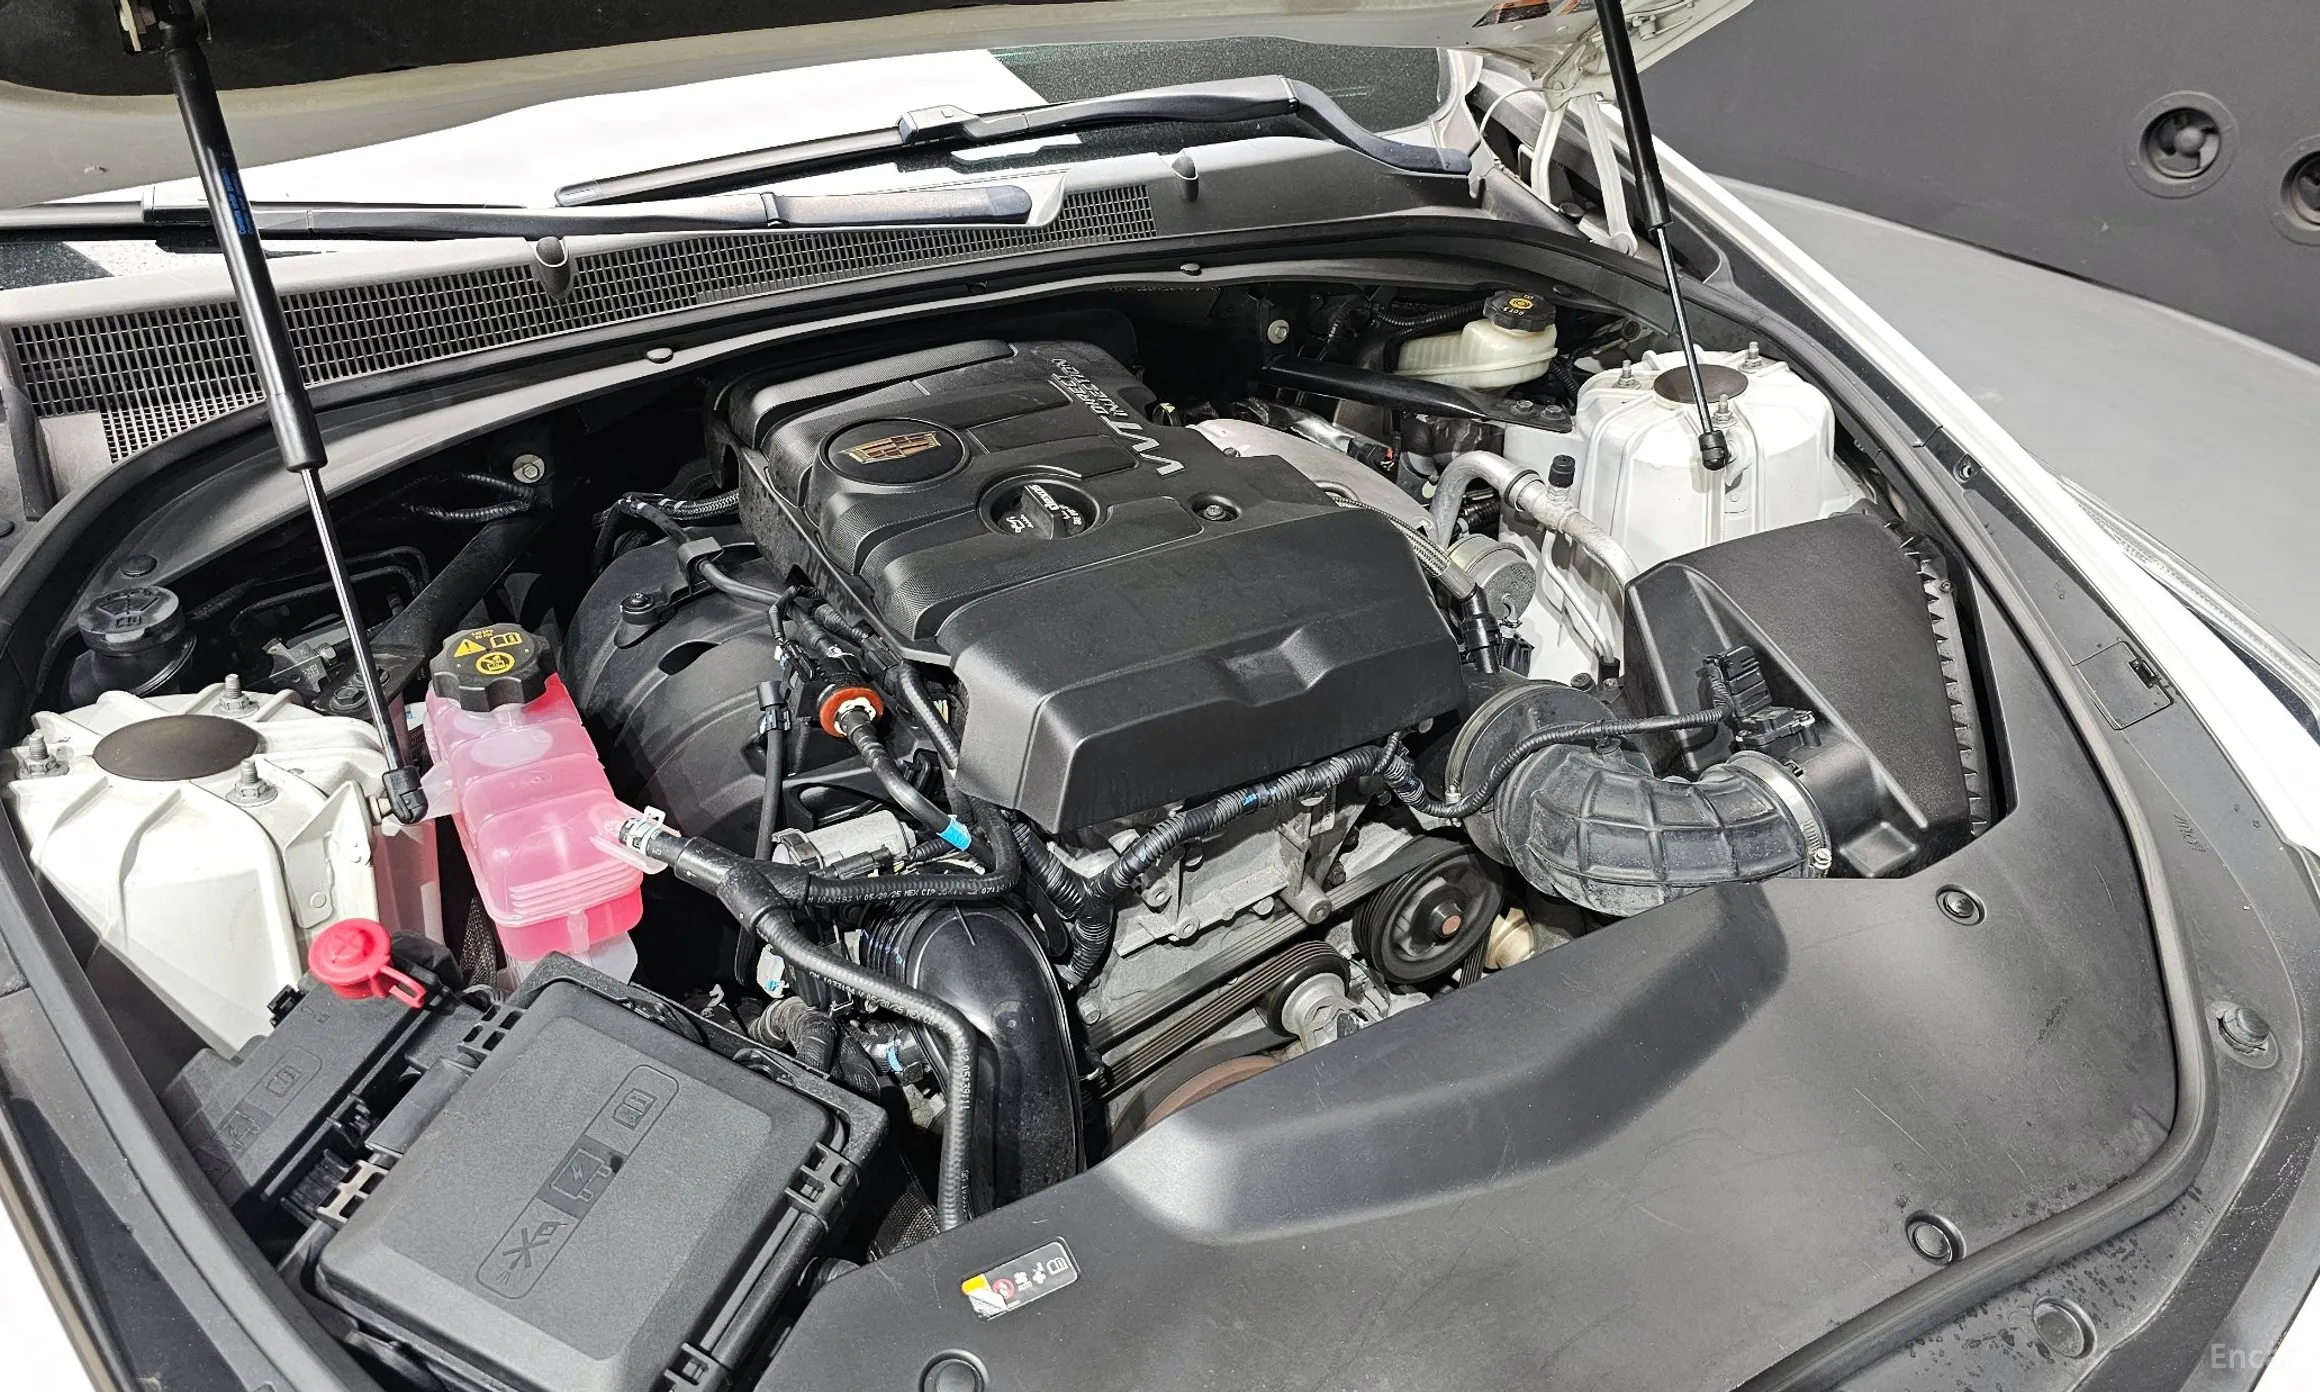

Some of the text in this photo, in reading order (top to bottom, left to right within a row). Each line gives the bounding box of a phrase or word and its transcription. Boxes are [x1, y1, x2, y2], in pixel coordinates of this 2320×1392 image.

[1050, 373, 1110, 416] DIRECT
[1051, 358, 1129, 417] INJECTION
[1027, 484, 1060, 511] dexos
